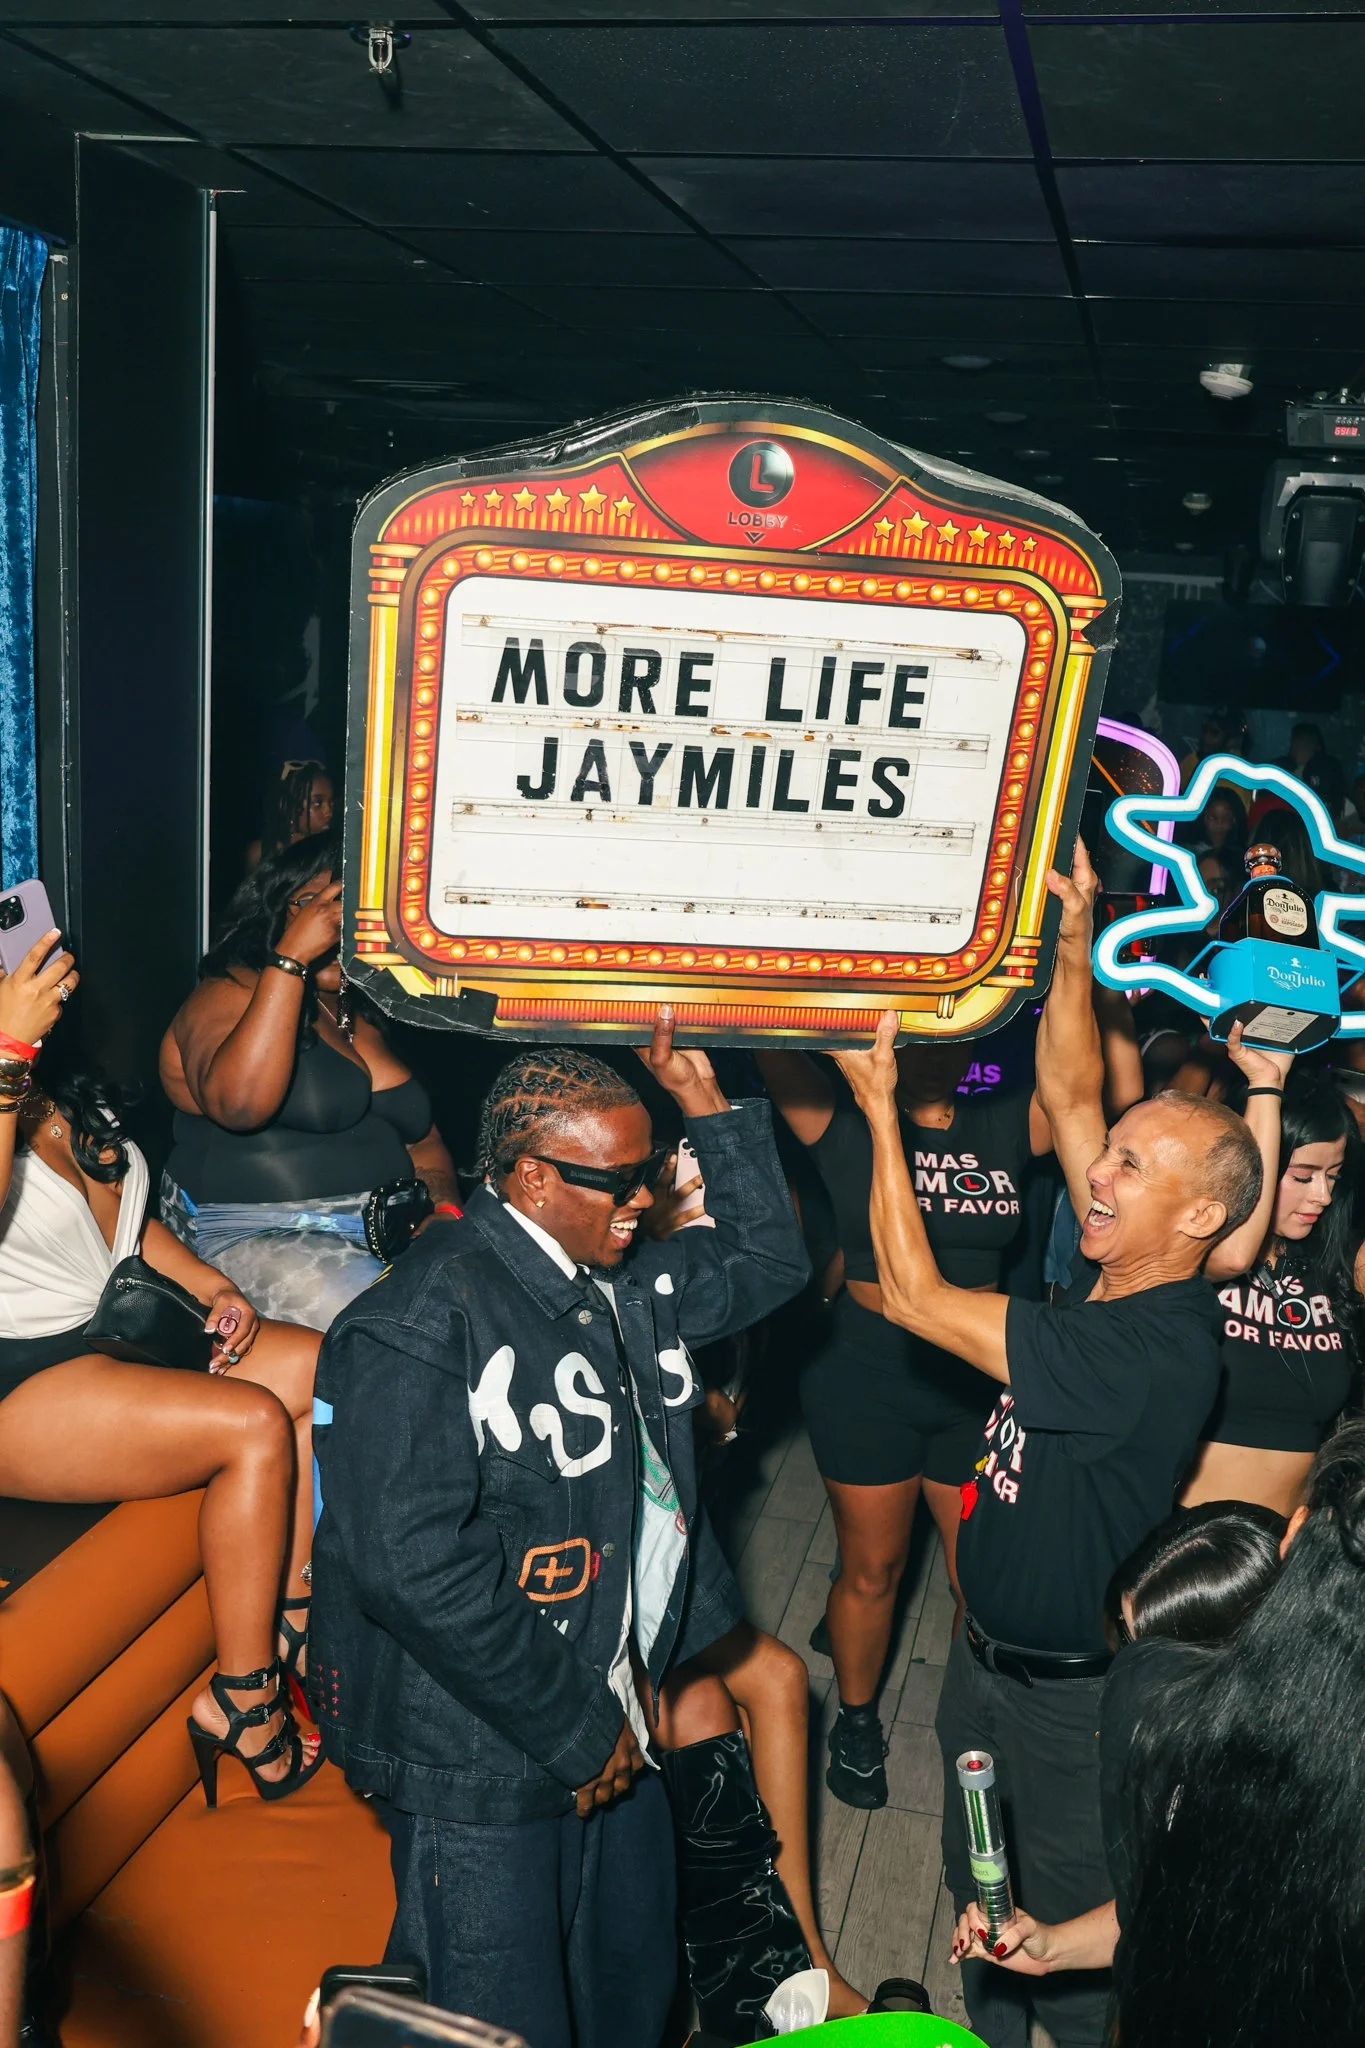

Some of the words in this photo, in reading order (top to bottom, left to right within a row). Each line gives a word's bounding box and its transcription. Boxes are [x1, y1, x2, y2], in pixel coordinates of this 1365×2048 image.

[728, 511, 788, 529] LOBBY
[491, 636, 714, 718] MORE
[765, 655, 929, 729] LIFE
[516, 735, 911, 819] JAYMILES
[1267, 966, 1296, 982] Don
[1291, 970, 1326, 989] Julio
[961, 1062, 1002, 1084] AS
[914, 1151, 979, 1170] MAS
[944, 1198, 1020, 1216] FAVOR
[1223, 1319, 1261, 1344] OR
[1268, 1330, 1343, 1352] FAVOR
